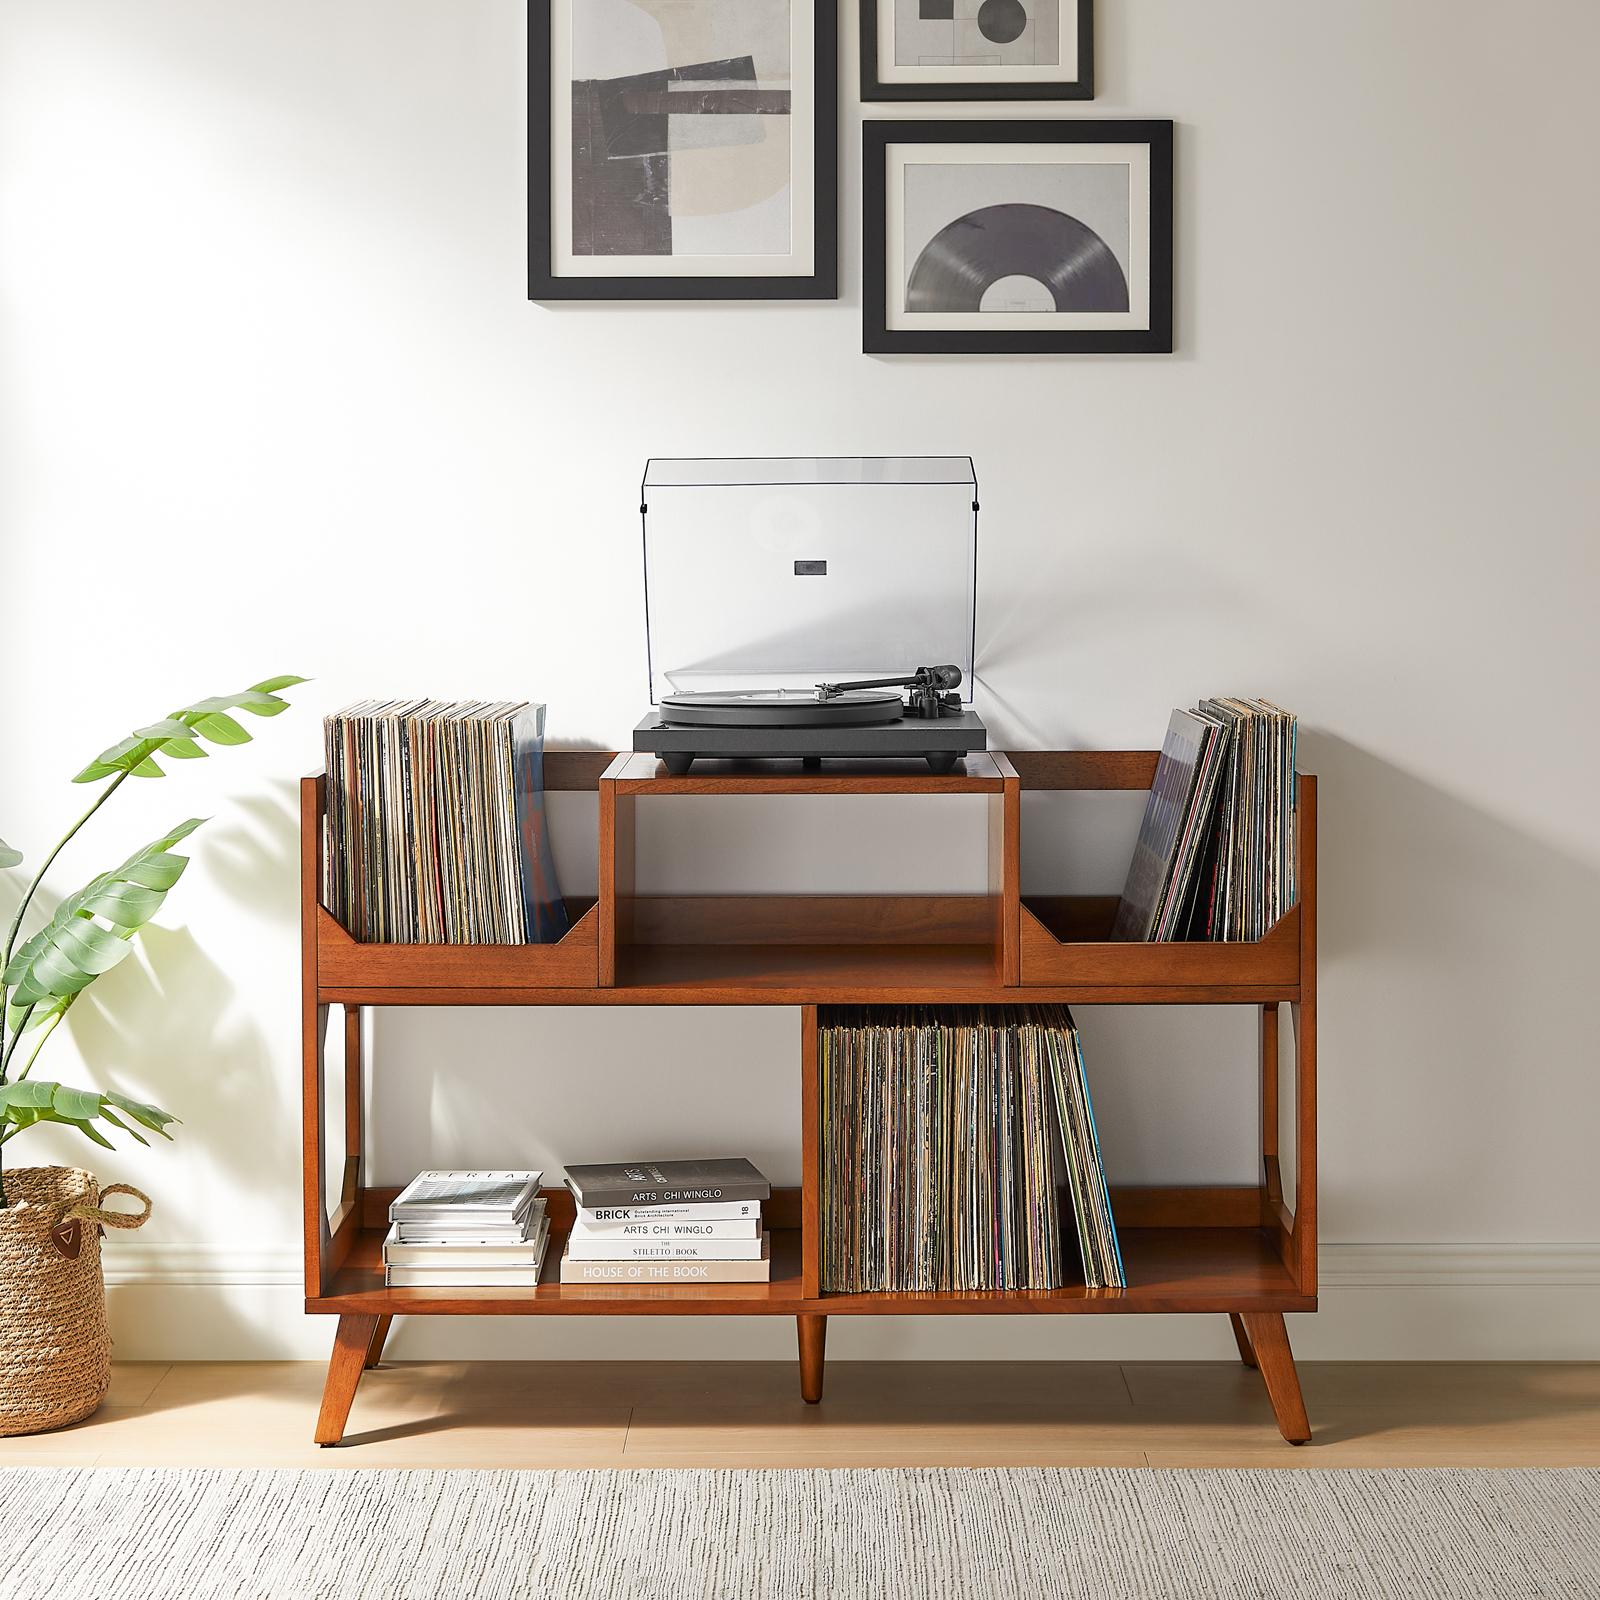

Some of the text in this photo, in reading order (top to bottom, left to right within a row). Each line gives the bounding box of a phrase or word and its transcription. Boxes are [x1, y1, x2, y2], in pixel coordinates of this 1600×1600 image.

[632, 1189, 722, 1201] ARTS CHI WINGLO
[595, 1209, 631, 1220] BRICK
[623, 1225, 714, 1234] ARTS CHI WINGLO
[632, 1248, 698, 1256] STILETTO BOOK
[583, 1266, 708, 1278] HOUSE OF THE BOOK
